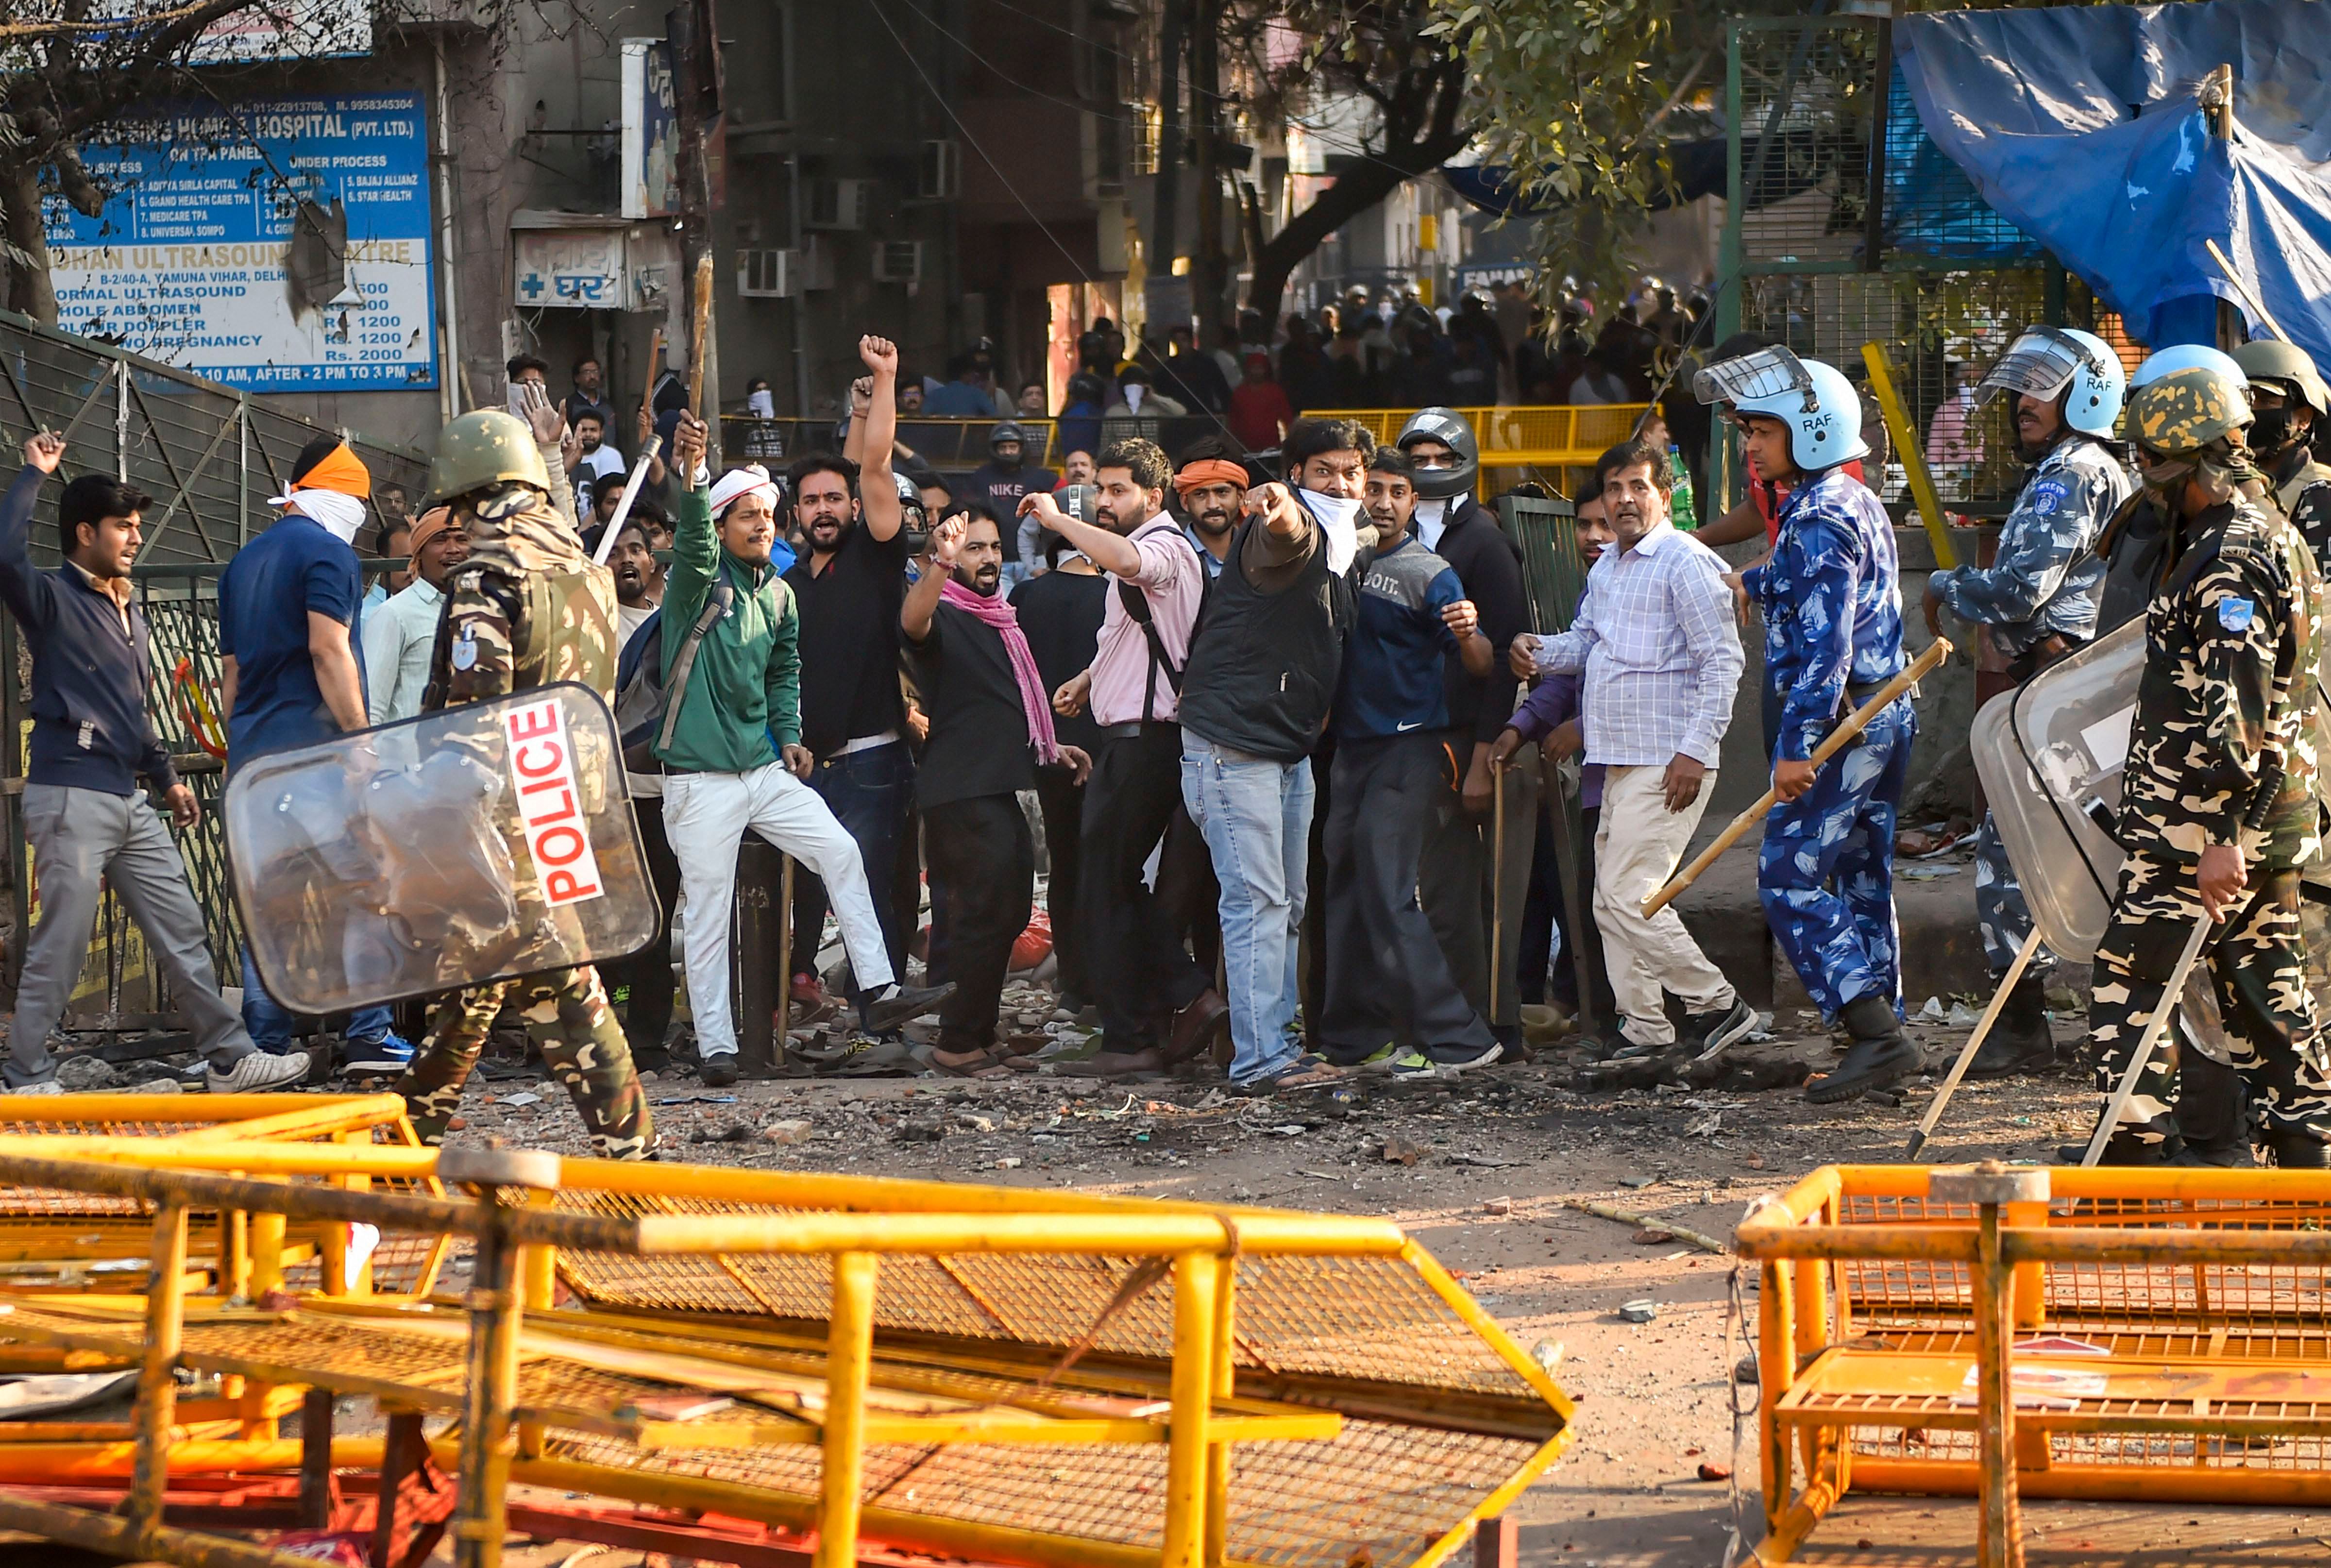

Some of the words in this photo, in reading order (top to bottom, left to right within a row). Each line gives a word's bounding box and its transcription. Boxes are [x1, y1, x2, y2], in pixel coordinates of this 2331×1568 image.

[351, 99, 413, 111] 9958345304
[255, 114, 347, 140] HOSPITAL
[351, 121, 381, 140] (PVT.
[384, 120, 414, 140] LTD.)
[169, 147, 188, 162] ON
[193, 147, 217, 161] TPA
[220, 145, 263, 161] PANEL
[290, 156, 329, 169] UNDER
[332, 155, 387, 168] PROCESS
[203, 178, 238, 190] CAPITAL
[347, 176, 355, 187] 5.
[356, 175, 382, 187] BAJAJ
[384, 174, 418, 186] ALLIANZ
[139, 196, 148, 207] 6.
[149, 195, 177, 207] GRAND
[178, 194, 210, 206] HEALTH
[211, 194, 233, 206] CARE
[234, 193, 251, 205] TPA
[348, 191, 355, 202] 6.
[357, 191, 378, 202] STAR
[380, 190, 412, 202] HEALTH
[140, 212, 148, 223] 7.
[150, 211, 190, 222] MEDICARE
[192, 210, 208, 221] TPA
[141, 227, 149, 238] 8.
[197, 224, 225, 236] SOMPO
[265, 223, 273, 235] 4.
[133, 243, 291, 269] ULTRASOUN
[101, 274, 152, 286] B-2/40-A,
[154, 272, 207, 284] YAMUNA
[210, 271, 251, 283] VIHAR,
[56, 289, 118, 301] ORMAL
[124, 287, 246, 300] ULTRASOUND
[554, 275, 606, 300] घर
[59, 305, 107, 317] HOLE
[112, 303, 202, 316] ABDOMEN
[59, 321, 118, 333] OLOUR
[124, 320, 206, 332] DOPPLER
[358, 316, 401, 328] 1200
[152, 335, 263, 348] PREGNANCY
[358, 333, 402, 344] 1200
[325, 351, 353, 361] Rs.
[359, 349, 402, 361] 2000
[206, 368, 222, 382] 10
[226, 368, 251, 383] AM,
[312, 367, 321, 380] 2
[325, 367, 346, 380] PM
[351, 366, 370, 379] TO
[386, 365, 406, 378] PM
[2087, 377, 2111, 391] RAF
[1803, 413, 1832, 432] RAF
[989, 484, 1024, 497] NIKE
[509, 703, 597, 903] POLICE
